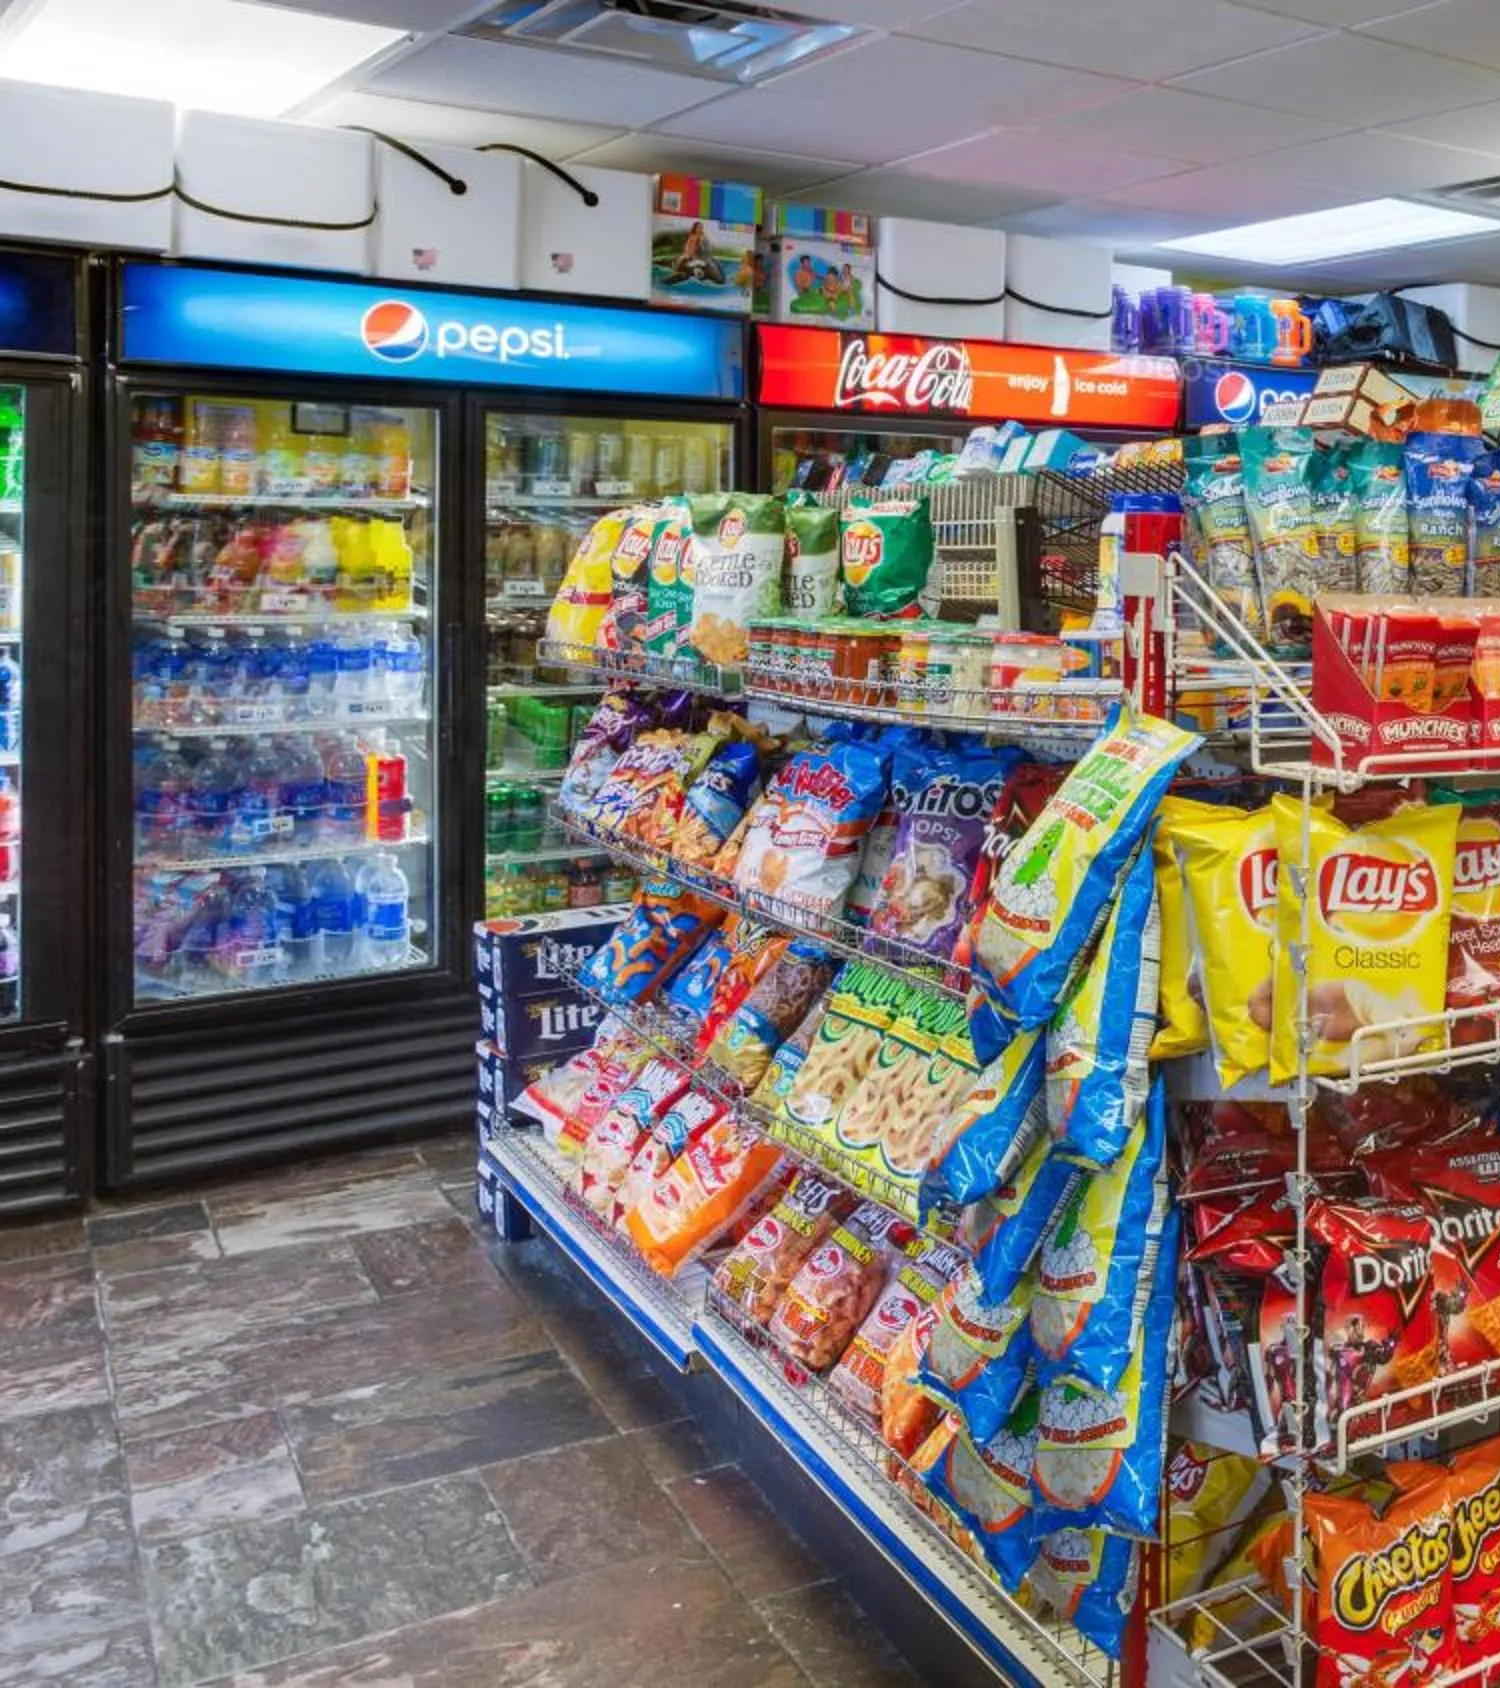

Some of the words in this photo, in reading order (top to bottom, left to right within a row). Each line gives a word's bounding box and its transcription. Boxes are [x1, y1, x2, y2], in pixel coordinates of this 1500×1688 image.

[436, 320, 566, 361] pepsi
[834, 339, 973, 410] Coca-Cola
[1008, 374, 1049, 393] enjoy
[1075, 378, 1095, 395] ice
[1097, 379, 1127, 396] cold
[1379, 716, 1467, 743] MUNCHIES
[1328, 857, 1429, 912] Lay's
[1334, 945, 1420, 969] Classic
[538, 1003, 599, 1040] Lite
[1354, 1246, 1430, 1296] Dorit
[1335, 1519, 1452, 1631] Cheetos
